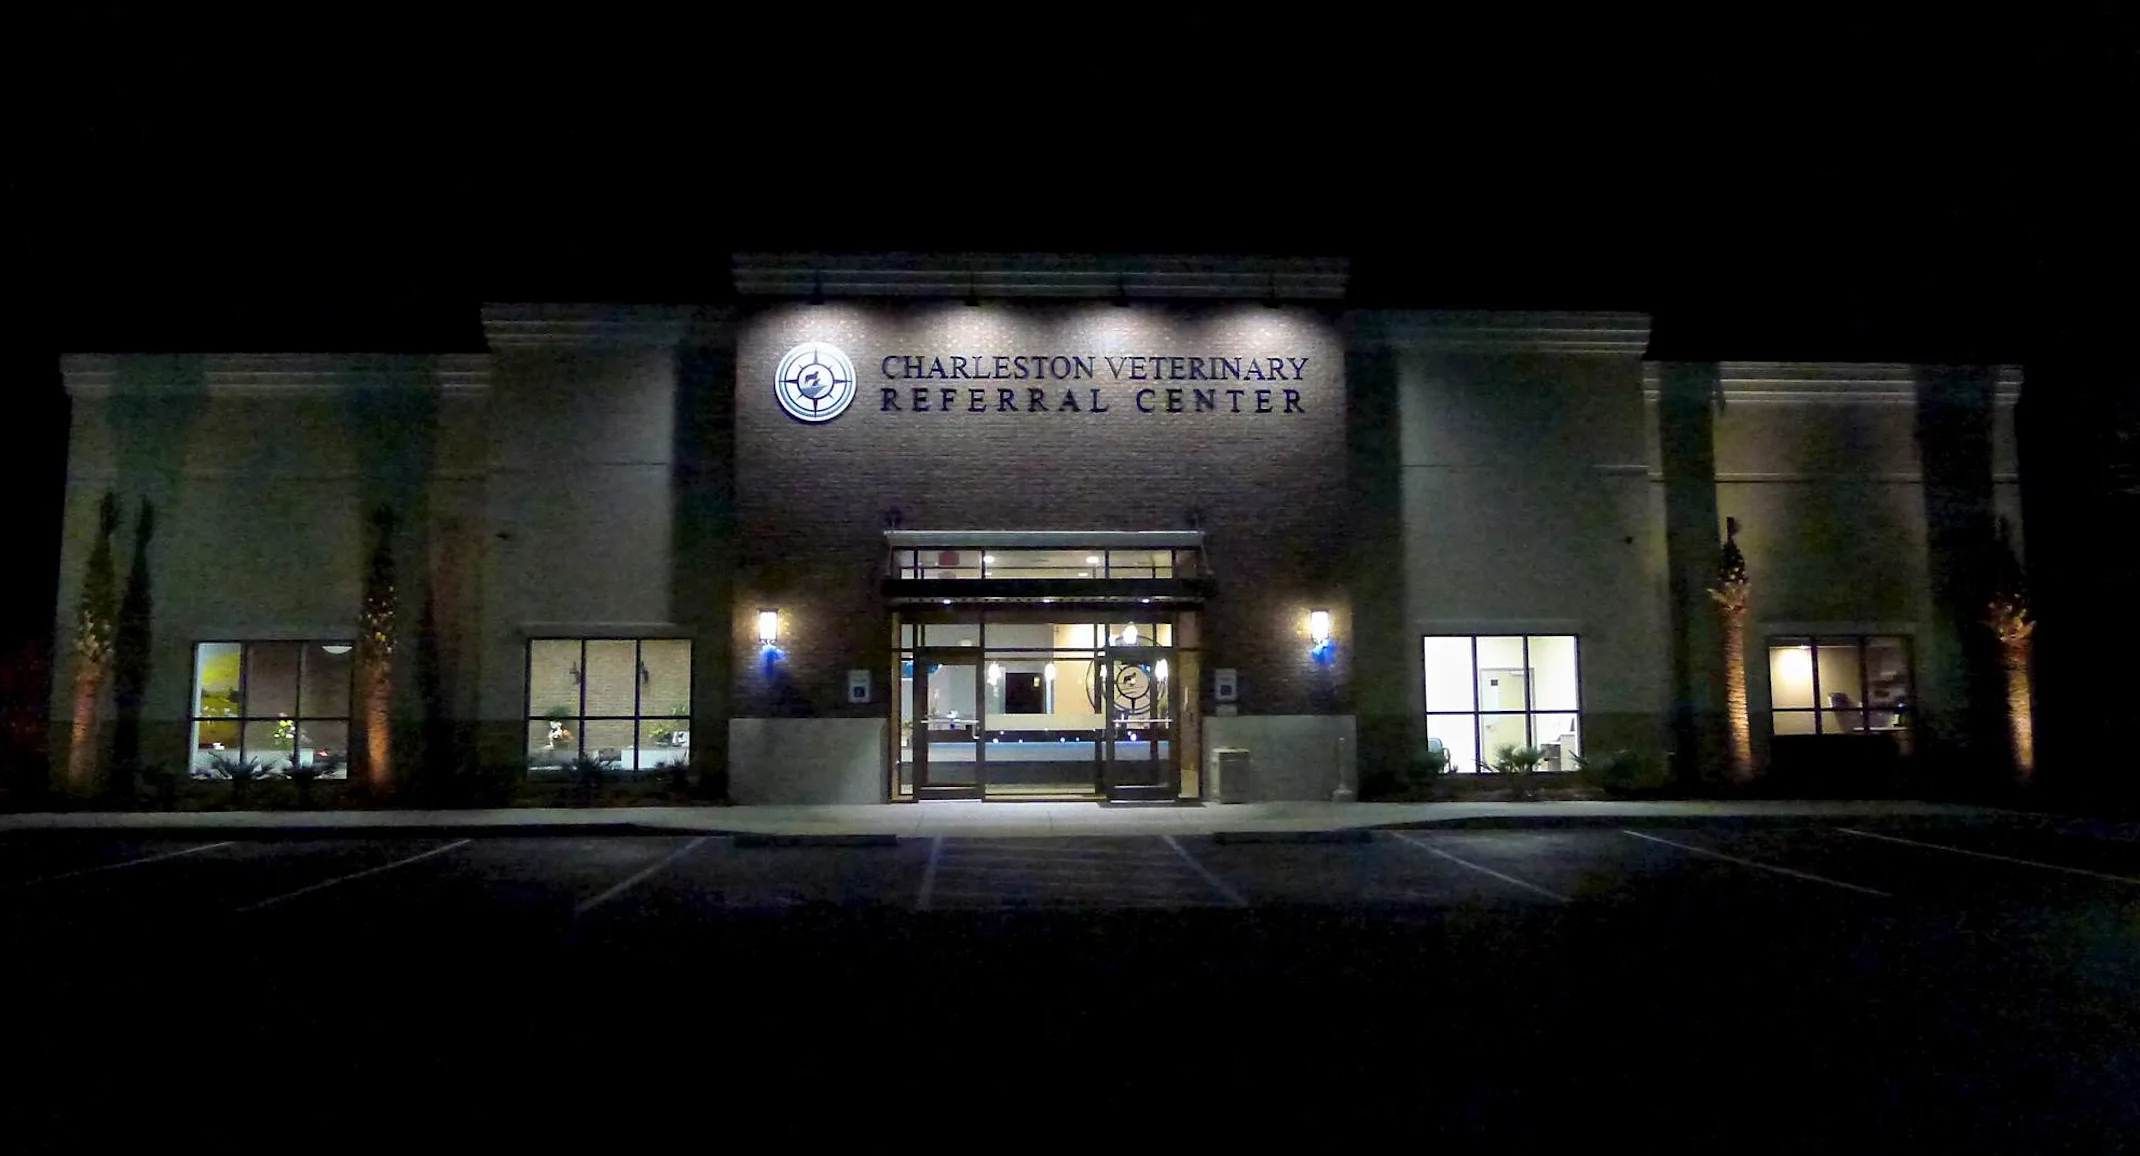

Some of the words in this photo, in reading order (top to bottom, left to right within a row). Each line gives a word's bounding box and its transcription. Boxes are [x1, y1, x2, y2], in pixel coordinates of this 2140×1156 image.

[881, 355, 1095, 380] CHARLESTON
[1105, 356, 1309, 380] VETERINARY
[880, 387, 1109, 413] REFERRAL
[1136, 388, 1305, 413] CENTER
